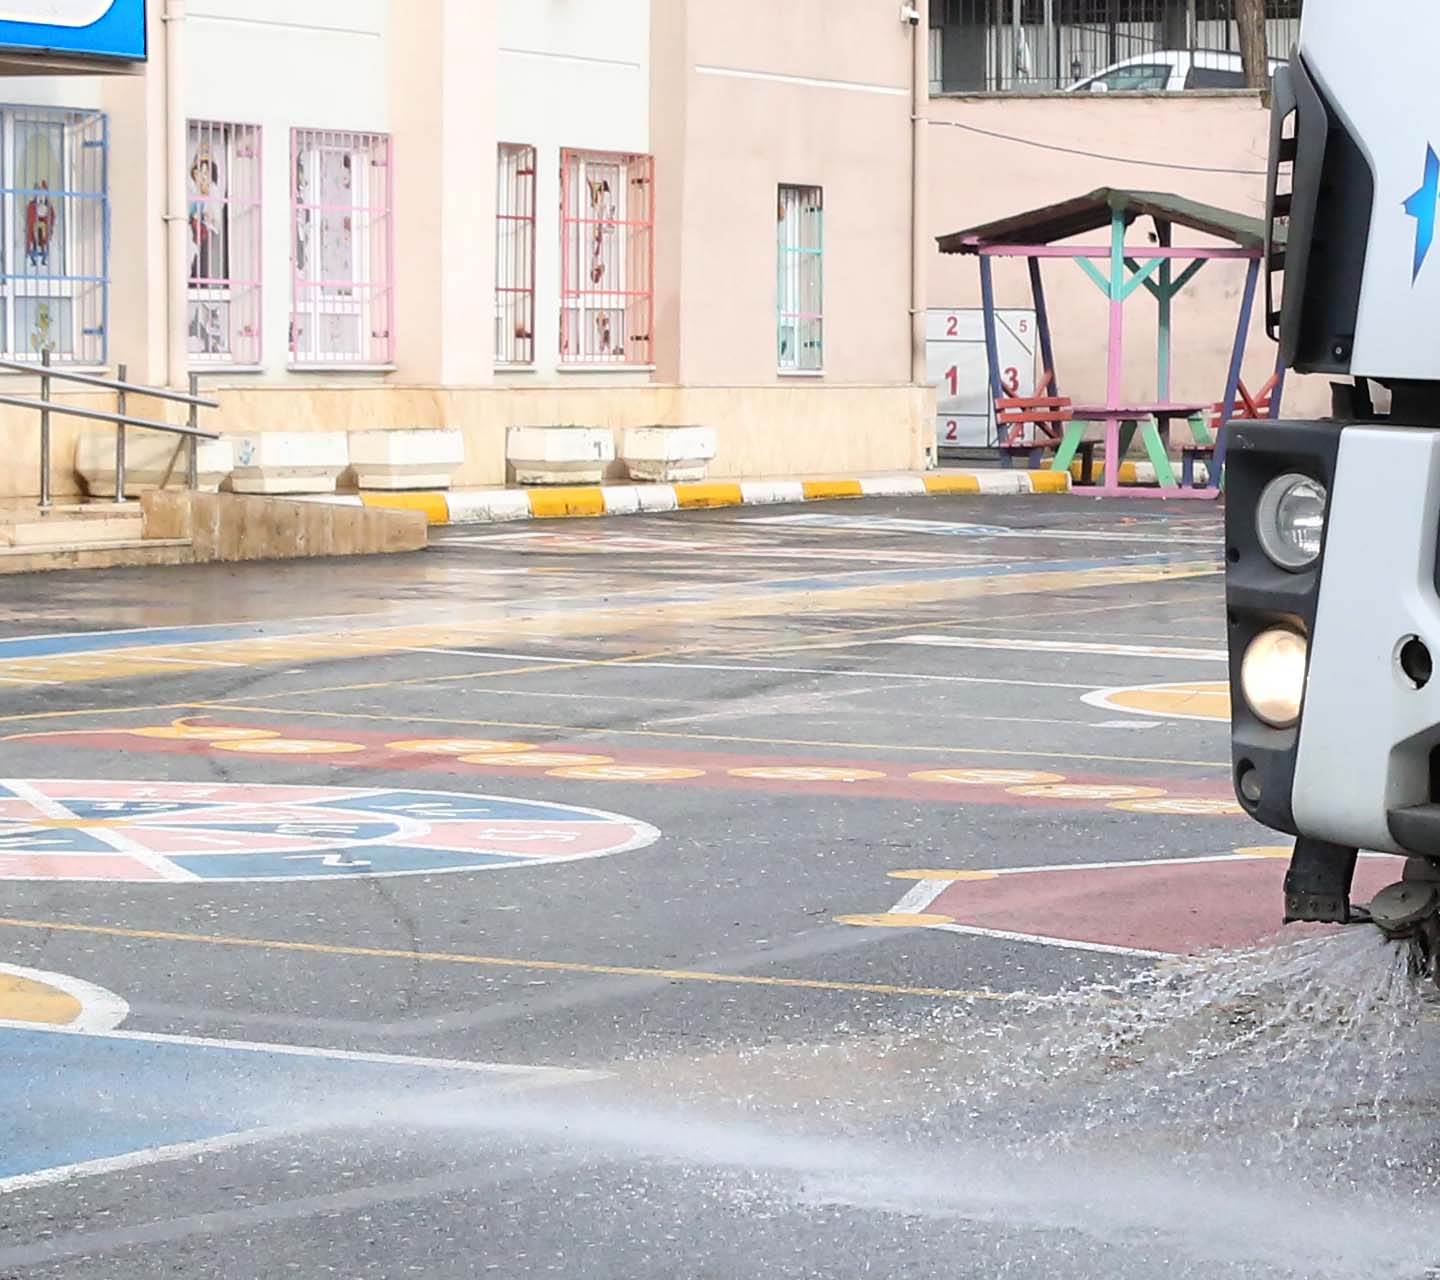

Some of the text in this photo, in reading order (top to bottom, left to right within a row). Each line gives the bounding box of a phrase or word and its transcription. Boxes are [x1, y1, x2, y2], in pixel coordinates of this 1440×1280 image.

[946, 315, 958, 336] 2
[1019, 319, 1028, 333] 5
[944, 365, 958, 395] 1
[1003, 367, 1019, 392] 3
[945, 420, 957, 440] 2
